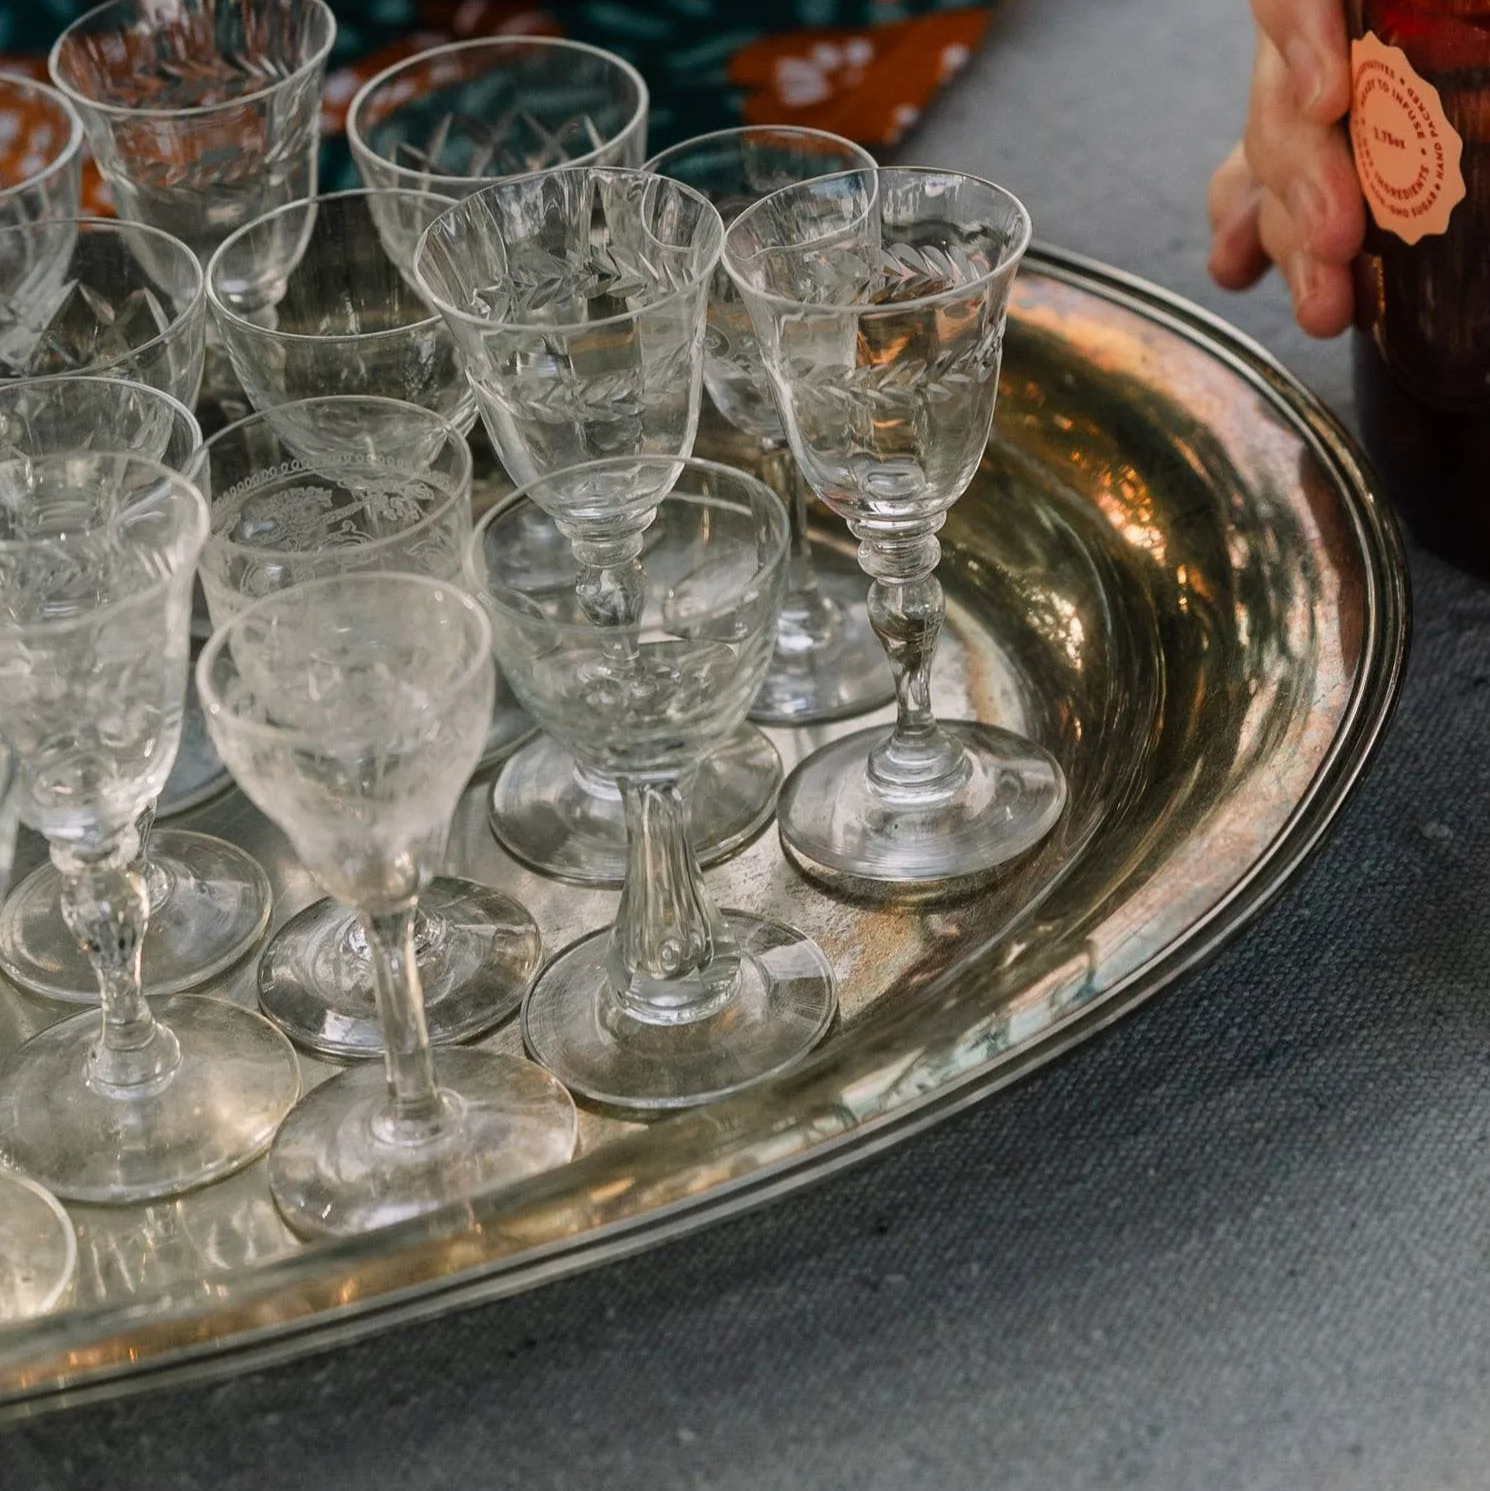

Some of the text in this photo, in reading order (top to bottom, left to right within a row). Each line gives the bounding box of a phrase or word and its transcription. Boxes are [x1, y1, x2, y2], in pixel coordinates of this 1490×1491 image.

[1392, 89, 1426, 139] INFUSE
[1407, 88, 1445, 180] HAND PACKED
